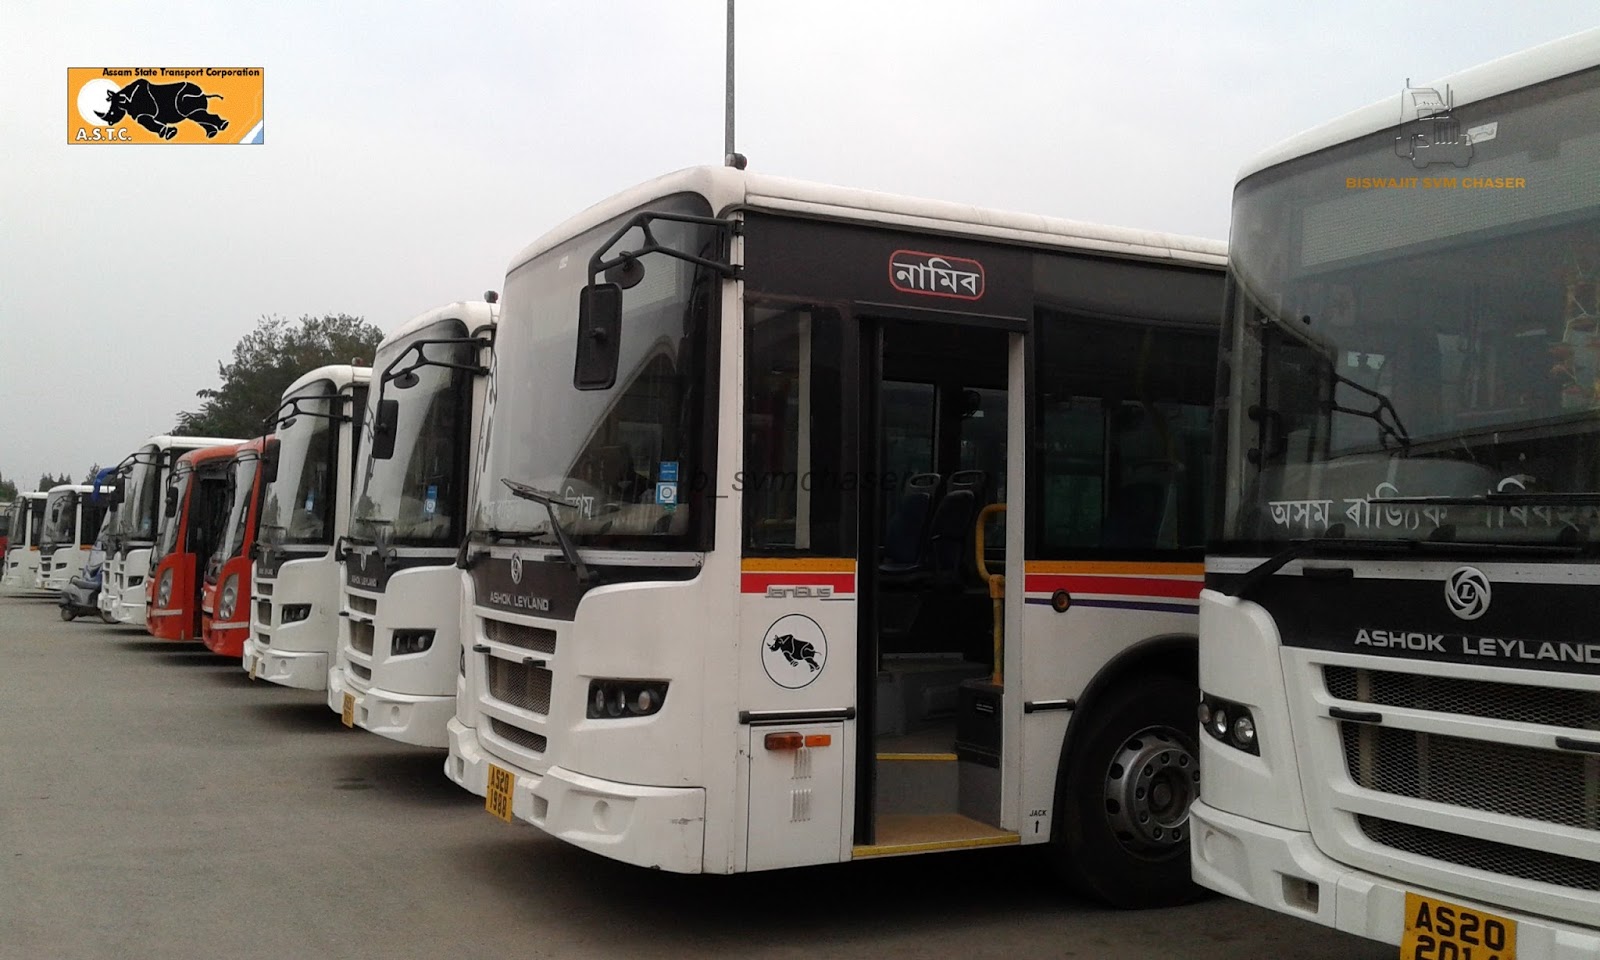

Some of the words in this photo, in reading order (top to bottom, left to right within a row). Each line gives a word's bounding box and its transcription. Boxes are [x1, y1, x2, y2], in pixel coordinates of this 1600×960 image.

[1268, 499, 1334, 529] অসম
[490, 591, 512, 606] ASHOK
[514, 595, 549, 611] LEYLAND
[1354, 628, 1446, 653] ASHOK
[1462, 636, 1600, 664] LEYLAND
[1029, 809, 1047, 817] JACK
[1415, 901, 1505, 952] AS20
[1415, 934, 1500, 960] 20
